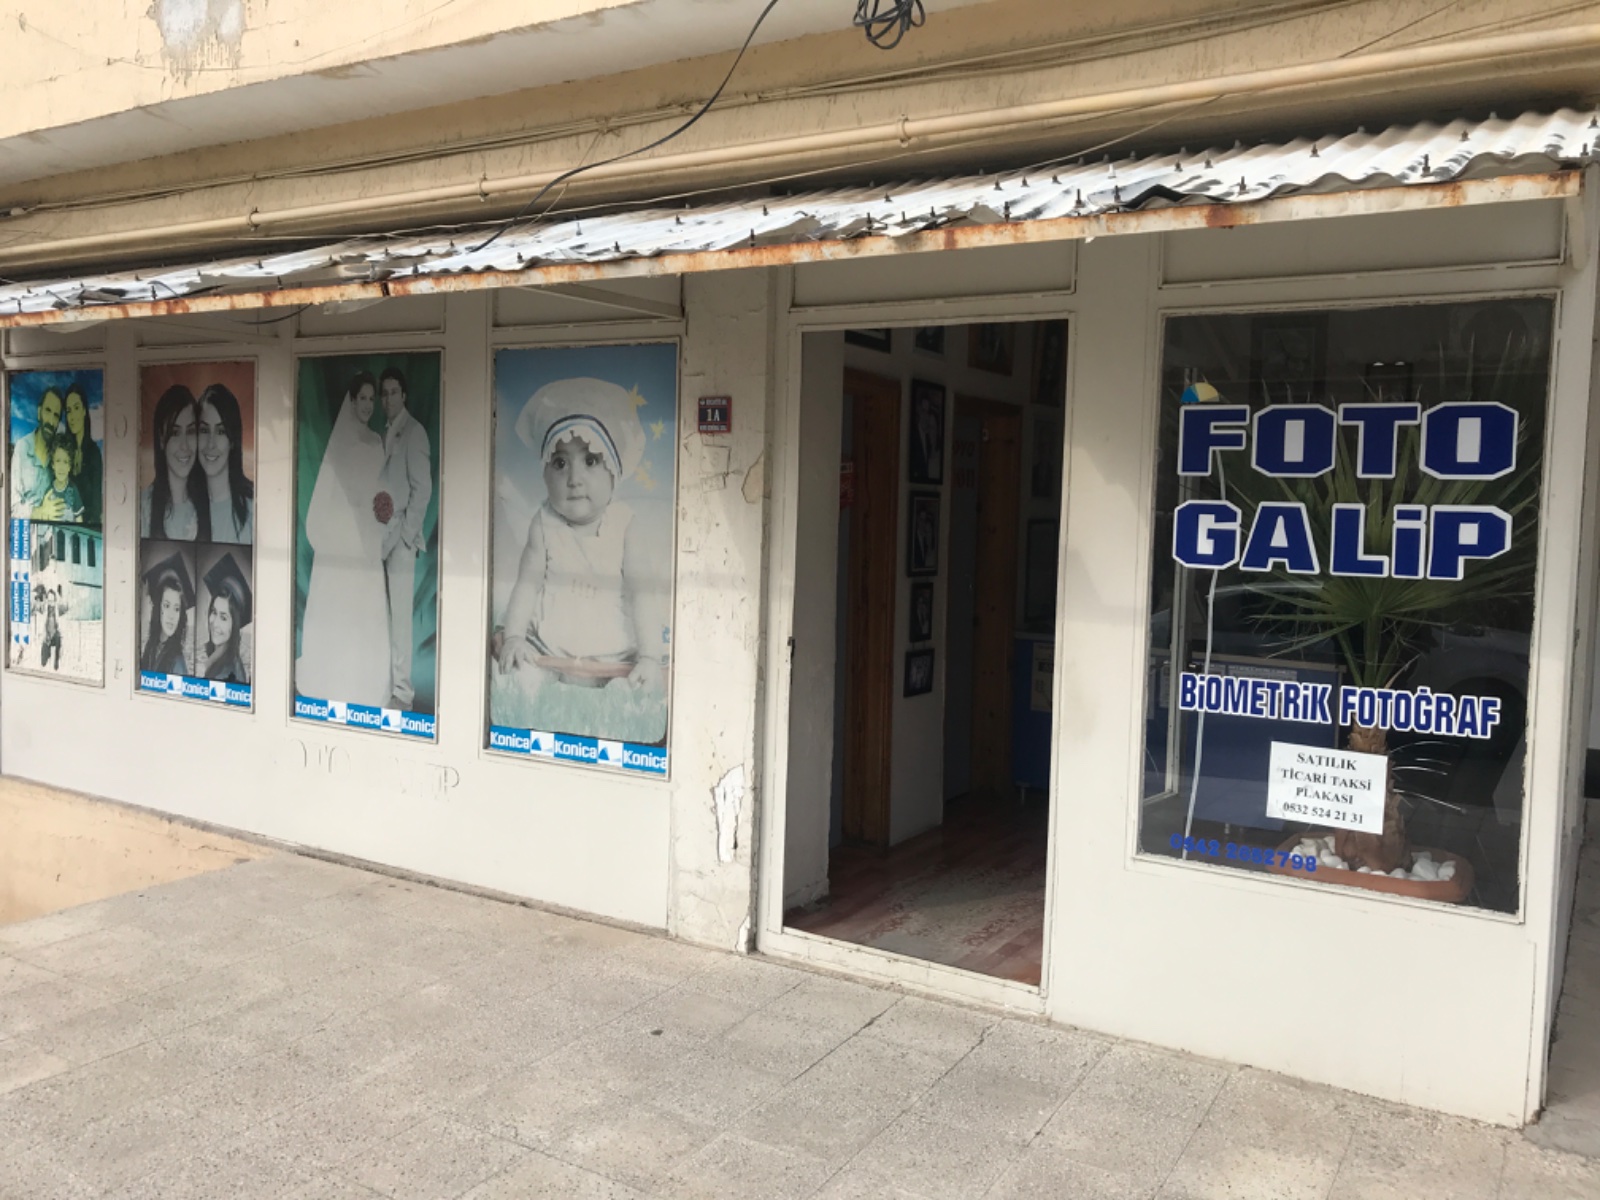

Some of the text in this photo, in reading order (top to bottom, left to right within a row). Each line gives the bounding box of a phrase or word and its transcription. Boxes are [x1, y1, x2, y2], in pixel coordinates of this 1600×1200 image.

[1177, 401, 1519, 480] FOTO
[141, 674, 167, 688] Konica
[182, 681, 210, 696] Konica
[296, 701, 328, 717] Konica
[346, 709, 381, 726] Konica
[1340, 685, 1501, 738] FOTOĞRAF
[490, 731, 667, 769] Konica Konica Konica
[1296, 752, 1357, 771] SATILIK
[1281, 767, 1372, 791] TİCARİ TAKSİ
[1296, 786, 1354, 805] PLAKASI
[1283, 802, 1363, 825] 0532 524 21 31
